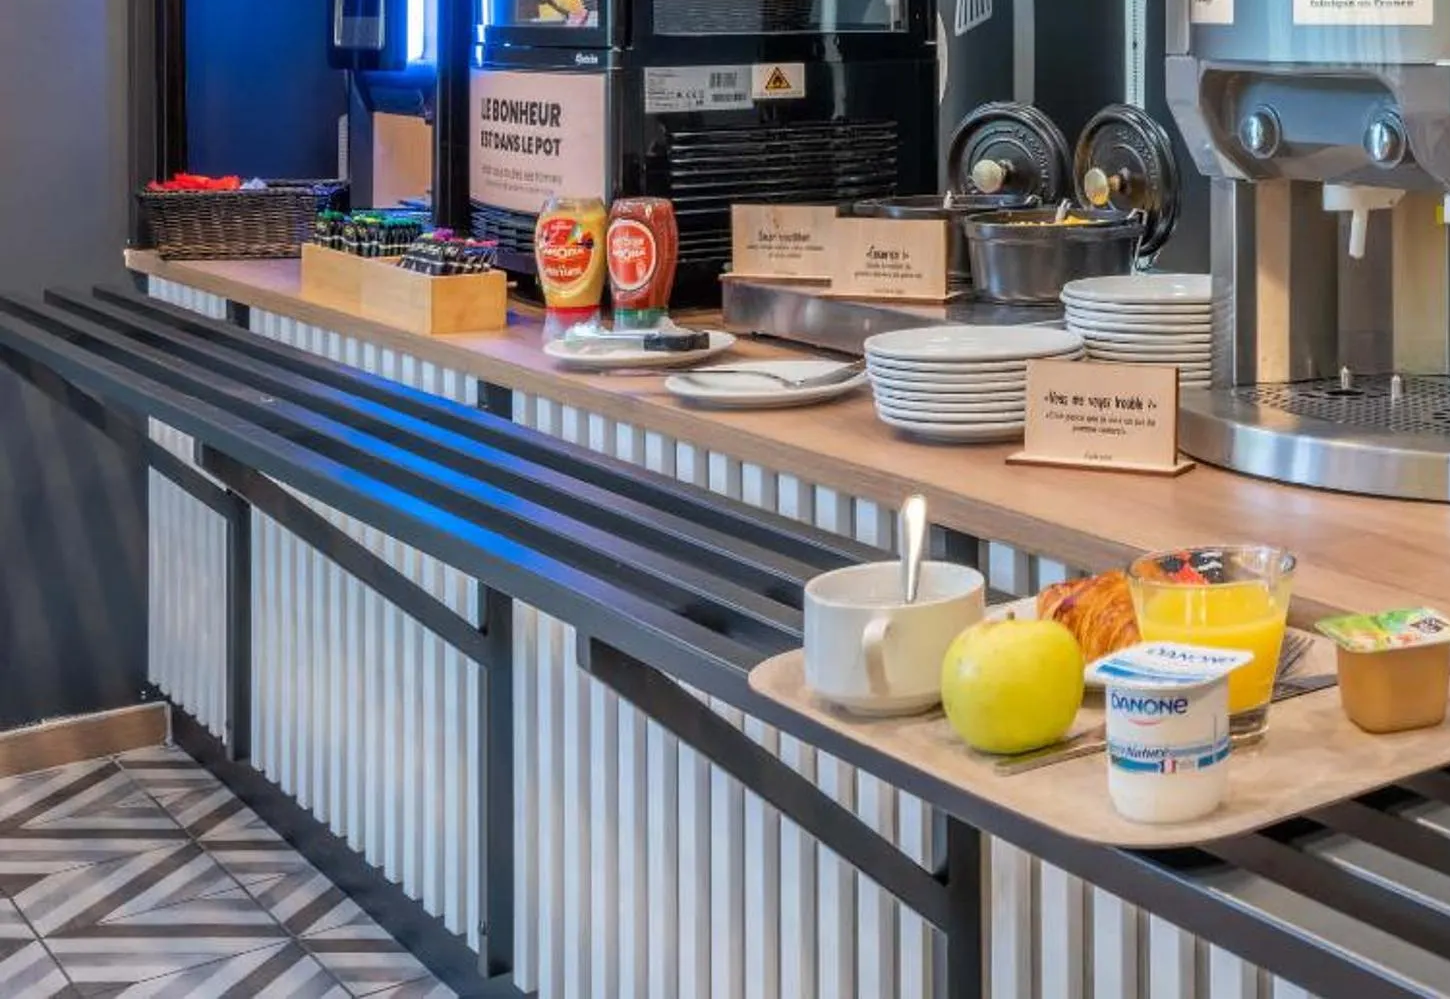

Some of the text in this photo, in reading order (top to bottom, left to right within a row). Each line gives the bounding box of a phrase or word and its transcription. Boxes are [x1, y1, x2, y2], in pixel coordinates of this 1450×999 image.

[493, 99, 562, 128] BONHEUR
[494, 131, 520, 153] DANS
[522, 135, 533, 154] LE
[535, 137, 562, 157] POT
[1111, 692, 1189, 715] DANONE
